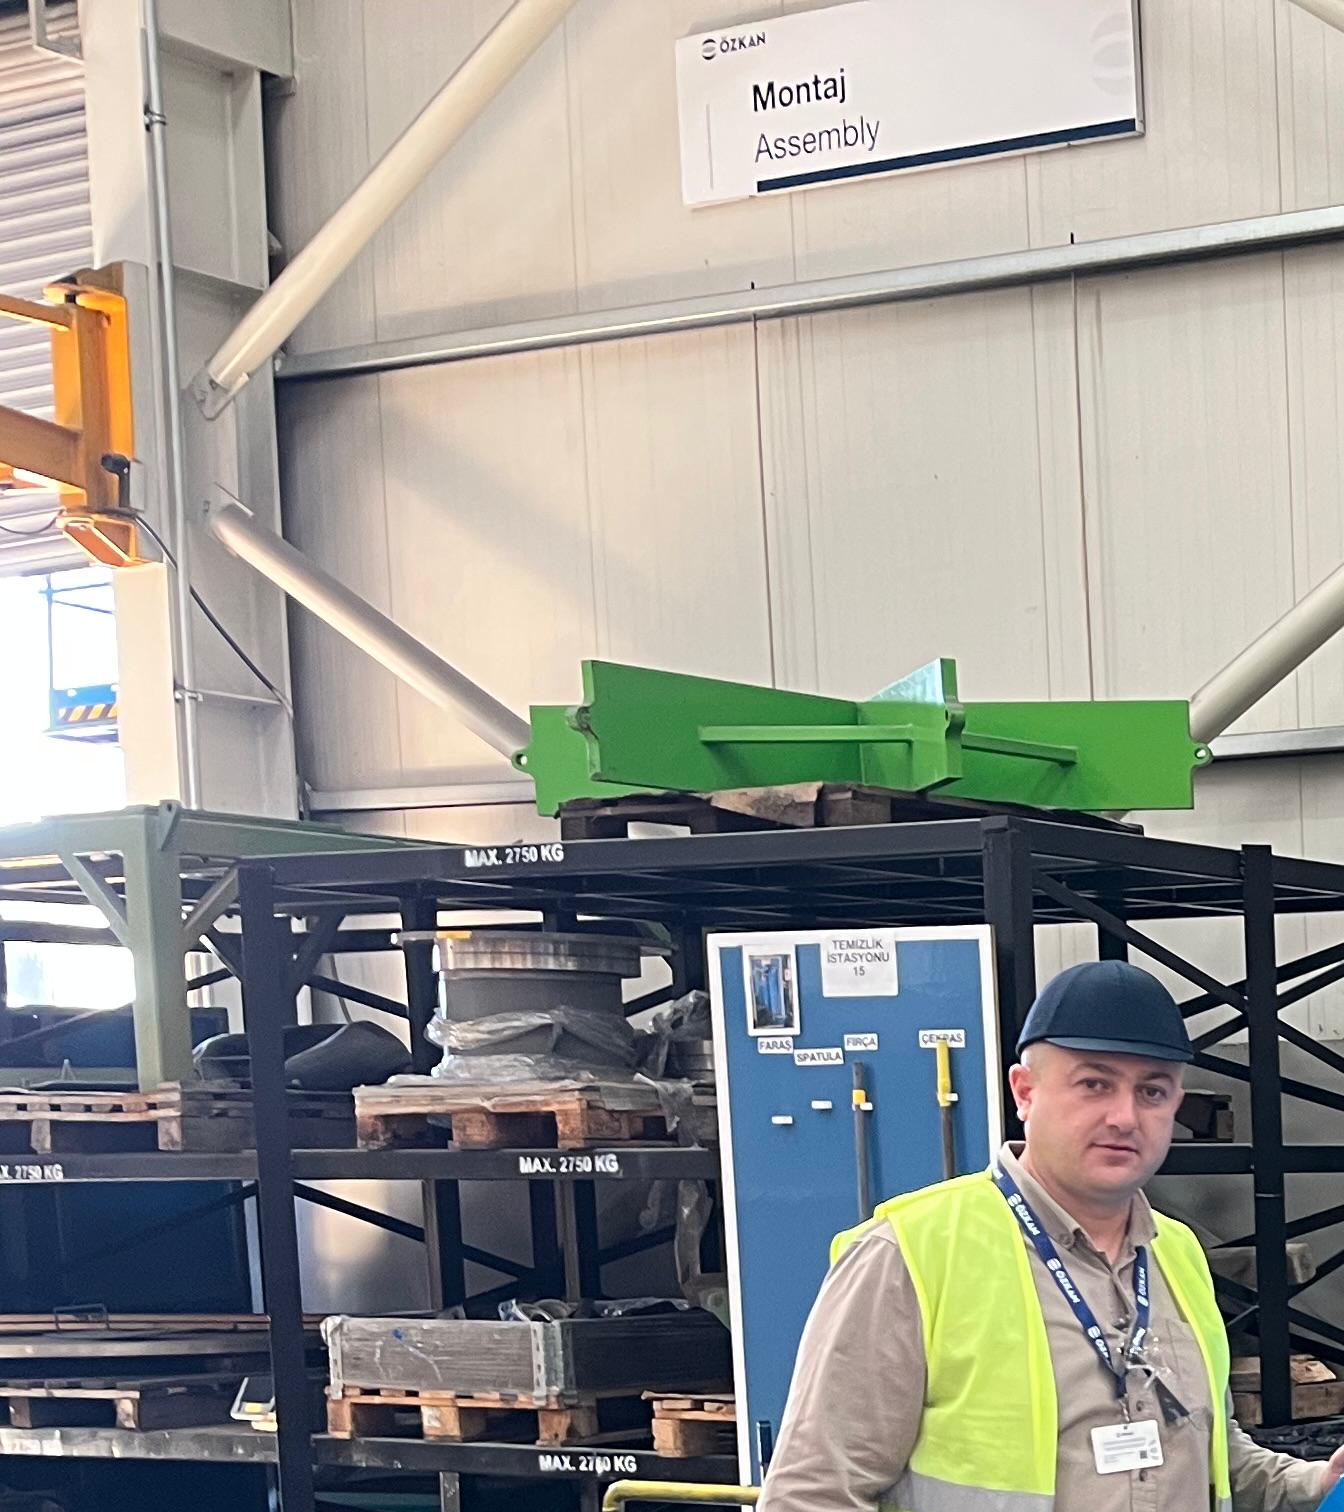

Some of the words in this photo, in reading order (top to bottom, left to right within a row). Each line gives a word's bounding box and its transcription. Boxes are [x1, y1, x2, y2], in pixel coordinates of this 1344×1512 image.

[720, 32, 767, 53] ÖZKAN
[752, 67, 846, 113] Montaj
[755, 116, 880, 163] Assembly
[464, 848, 503, 868] MAX.
[505, 846, 539, 864] 2750
[540, 843, 565, 862] KG
[853, 965, 866, 976] 15
[846, 1036, 877, 1049] FIRÇA
[796, 1051, 842, 1063] SPATULA
[43, 1163, 64, 1180] KG
[518, 1155, 557, 1174] MAX.
[559, 1155, 593, 1173] 2750
[594, 1153, 619, 1173] KG
[538, 1454, 576, 1472] MAX.
[613, 1455, 638, 1473] KG
